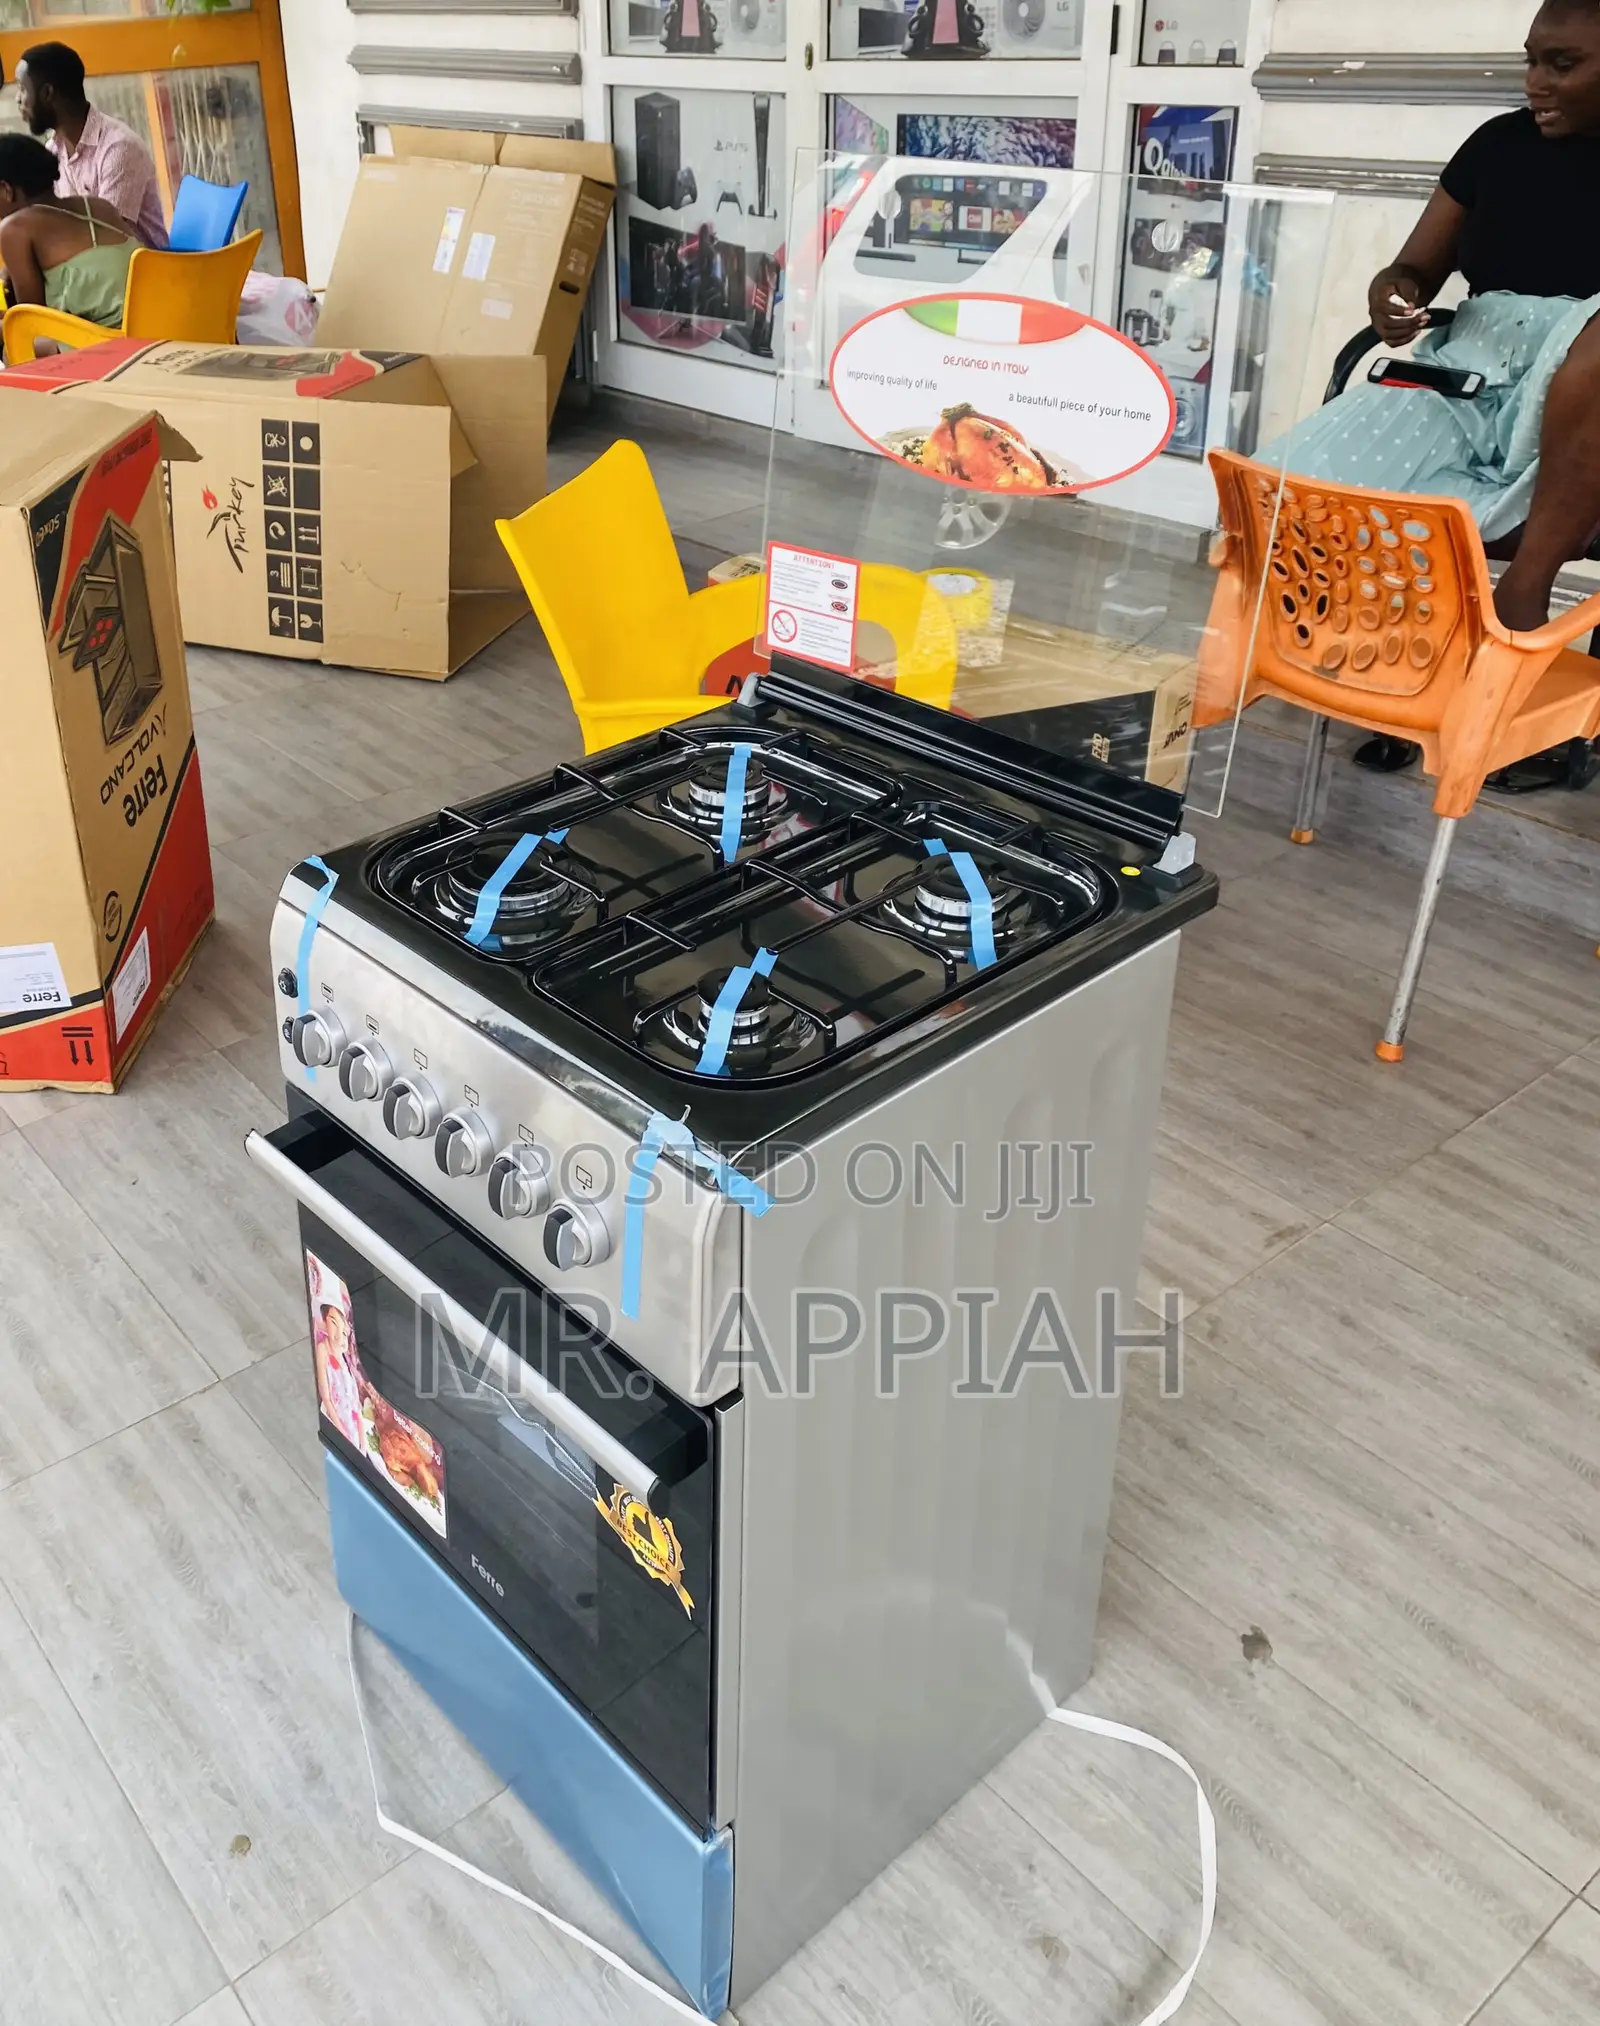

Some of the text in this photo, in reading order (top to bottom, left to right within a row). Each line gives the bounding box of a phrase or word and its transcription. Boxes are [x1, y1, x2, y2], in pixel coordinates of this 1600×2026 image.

[847, 368, 938, 390] improving quality of life
[991, 361, 1001, 371] IN
[1008, 392, 1152, 421] a beautifull piece of your home
[100, 721, 159, 805] VOLCANO
[123, 754, 168, 828] Ferre
[22, 991, 62, 1003] Ferre
[616, 1518, 638, 1542] BEST
[638, 1539, 671, 1573] CHOICE
[471, 1554, 505, 1597] Ferre
